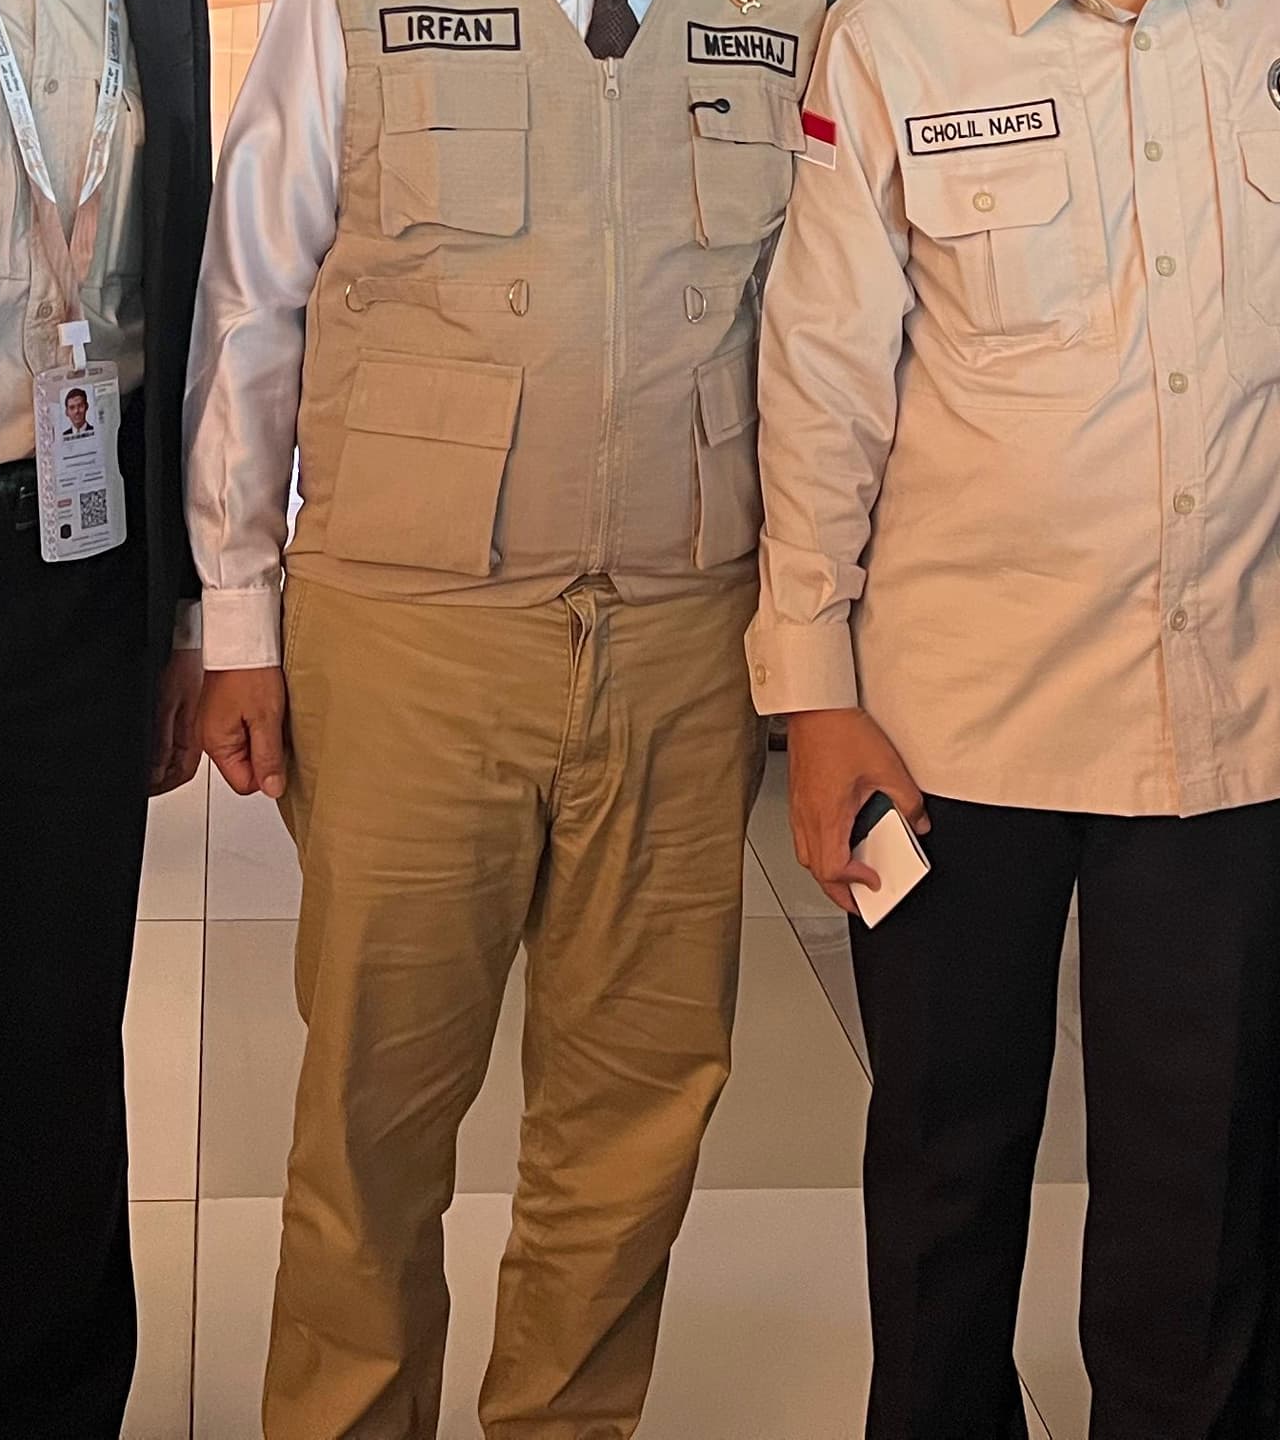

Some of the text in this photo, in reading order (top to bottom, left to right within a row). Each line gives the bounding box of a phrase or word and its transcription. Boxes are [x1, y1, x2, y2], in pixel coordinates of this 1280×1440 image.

[406, 16, 494, 43] IRFAN
[703, 32, 786, 65] MENHAJ
[920, 112, 1044, 145] CHOLIL NAFIS
